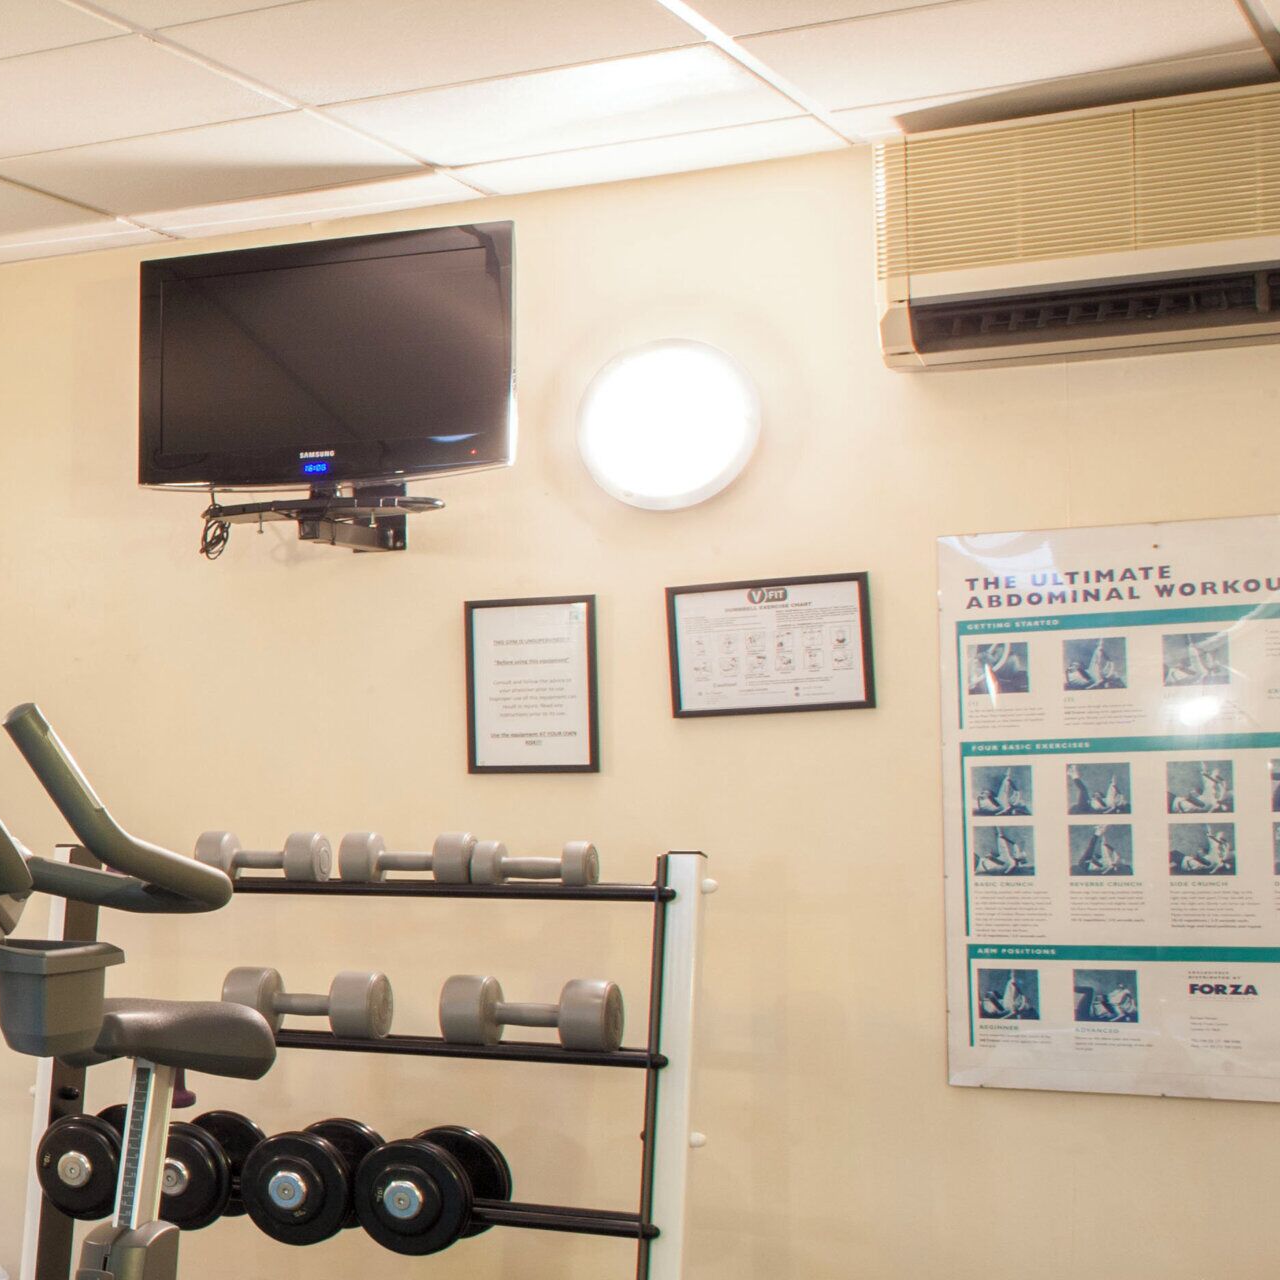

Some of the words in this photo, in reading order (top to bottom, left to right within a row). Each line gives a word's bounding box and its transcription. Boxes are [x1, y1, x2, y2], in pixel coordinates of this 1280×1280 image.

[300, 450, 334, 458] SAMSUNG
[965, 576, 1016, 590] THE
[1032, 565, 1170, 586] ULTIMATE
[769, 590, 784, 600] FIT
[966, 586, 1140, 609] ABDOMINAL
[967, 622, 1010, 630] GETTING
[1015, 619, 1059, 627] STARTED
[1036, 742, 1090, 750] EXERCISES
[1189, 984, 1258, 995] FORZA
